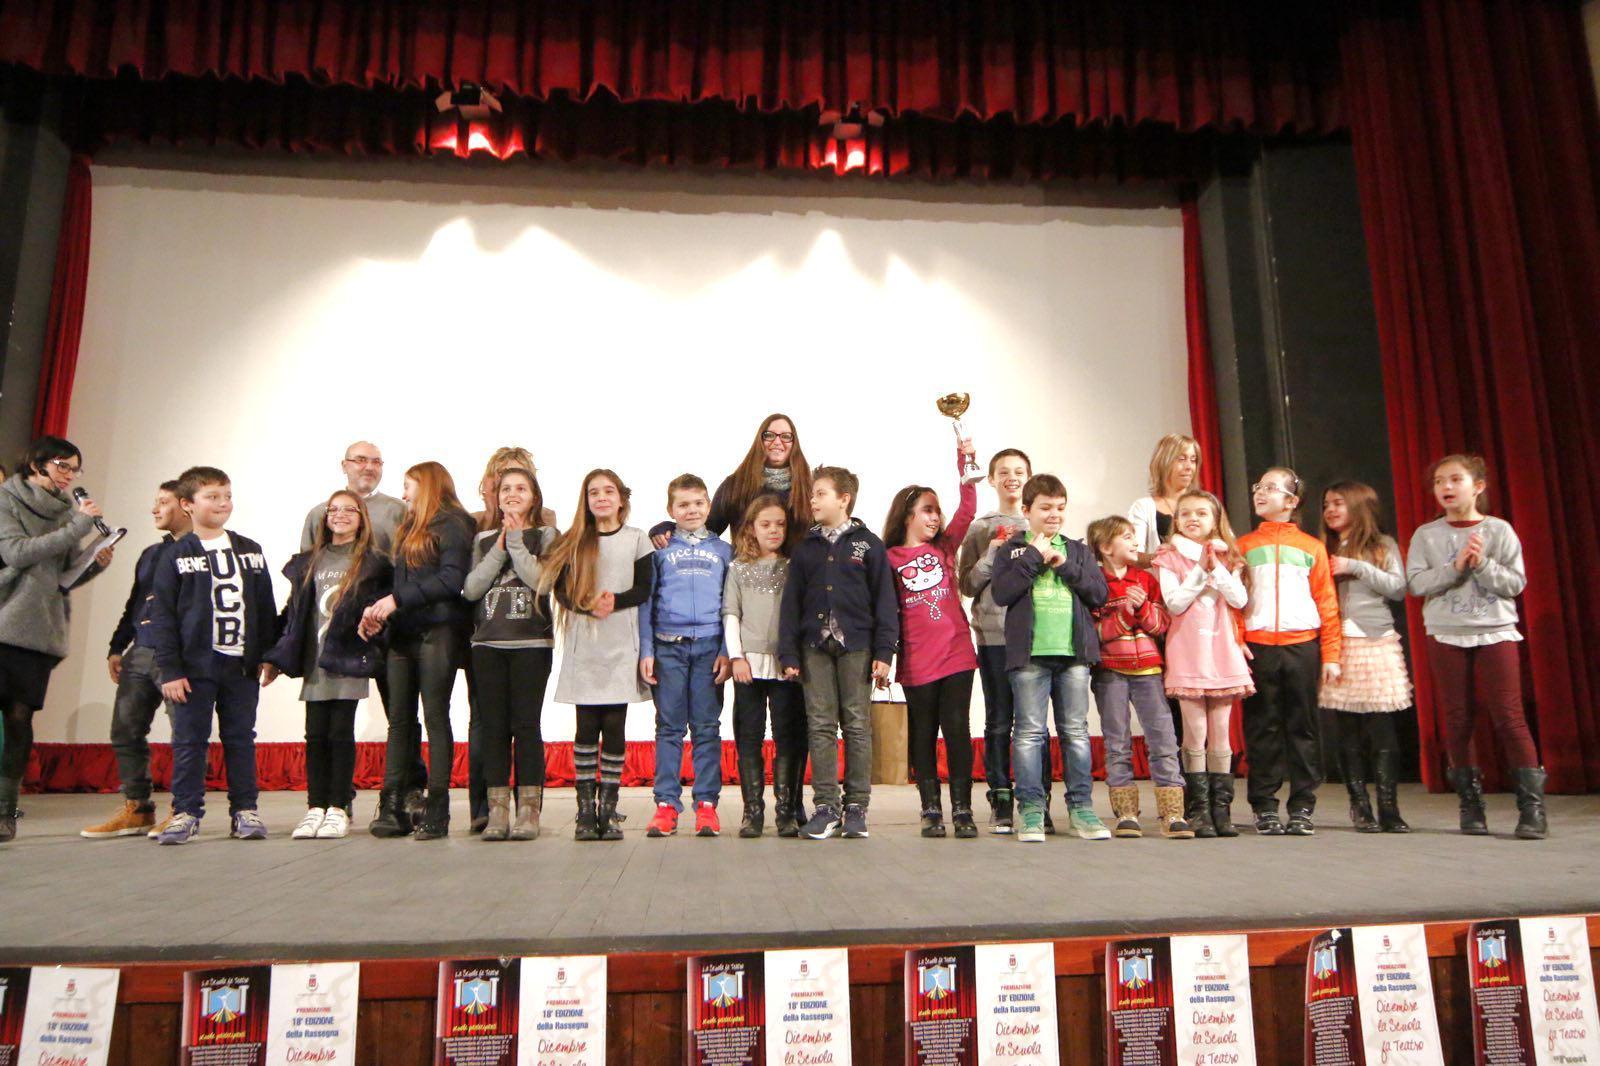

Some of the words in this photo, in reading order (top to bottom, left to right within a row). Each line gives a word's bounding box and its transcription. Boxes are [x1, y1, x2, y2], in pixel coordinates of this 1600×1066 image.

[176, 556, 209, 574] BENE
[1204, 983, 1230, 991] EDIZIONE
[1009, 993, 1035, 1001] EDIZIONE
[1189, 995, 1204, 1003] della
[1205, 995, 1235, 1003] Rassegna
[800, 1000, 828, 1009] EDIZIONE
[993, 1005, 1008, 1013] della
[1010, 1005, 1040, 1013] Rassegna
[555, 1009, 583, 1017] EDIZIONE
[783, 1013, 799, 1021] della
[801, 1013, 833, 1021] Rassegna
[1192, 1010, 1236, 1025] Dicembre
[305, 1016, 335, 1026] EDIZIONE
[537, 1022, 553, 1030] della
[555, 1022, 588, 1030] Rassegna
[286, 1030, 302, 1038] della
[304, 1030, 339, 1038] Rassegna
[996, 1021, 1040, 1036] Dicembre
[785, 1029, 832, 1045] Dicembre
[1204, 1030, 1238, 1045] Scuola
[538, 1038, 587, 1053] Dicembre
[1007, 1041, 1041, 1056] Scuola
[286, 1046, 336, 1062] Dicembre
[797, 1049, 833, 1065] Scuola
[1208, 1052, 1239, 1065] Teatro
